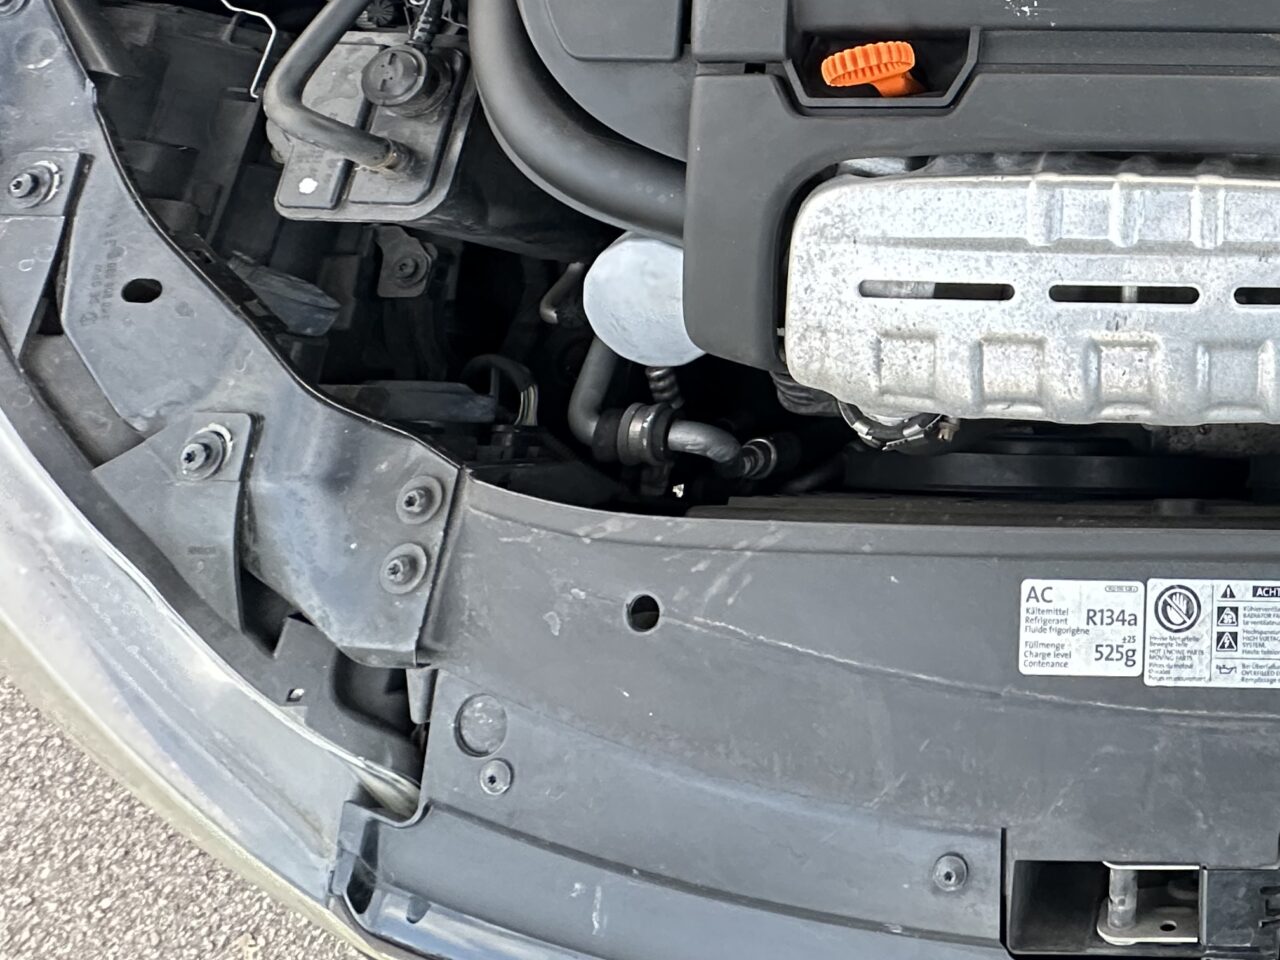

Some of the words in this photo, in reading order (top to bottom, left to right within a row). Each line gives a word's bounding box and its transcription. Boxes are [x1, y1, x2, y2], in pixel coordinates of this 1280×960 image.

[1025, 585, 1053, 603] AC
[1025, 607, 1069, 616] Kältemittel
[1024, 616, 1068, 626] Refrigerant
[1086, 608, 1138, 626] R134a
[1024, 626, 1048, 634] Fluide
[1049, 626, 1090, 637] frigorigène
[1122, 636, 1136, 644] ±25
[1024, 640, 1065, 651] Füllmenge
[1023, 651, 1052, 661] Charge
[1053, 651, 1071, 659] level
[1094, 644, 1137, 668] 525g
[1023, 660, 1069, 668] Contenance
